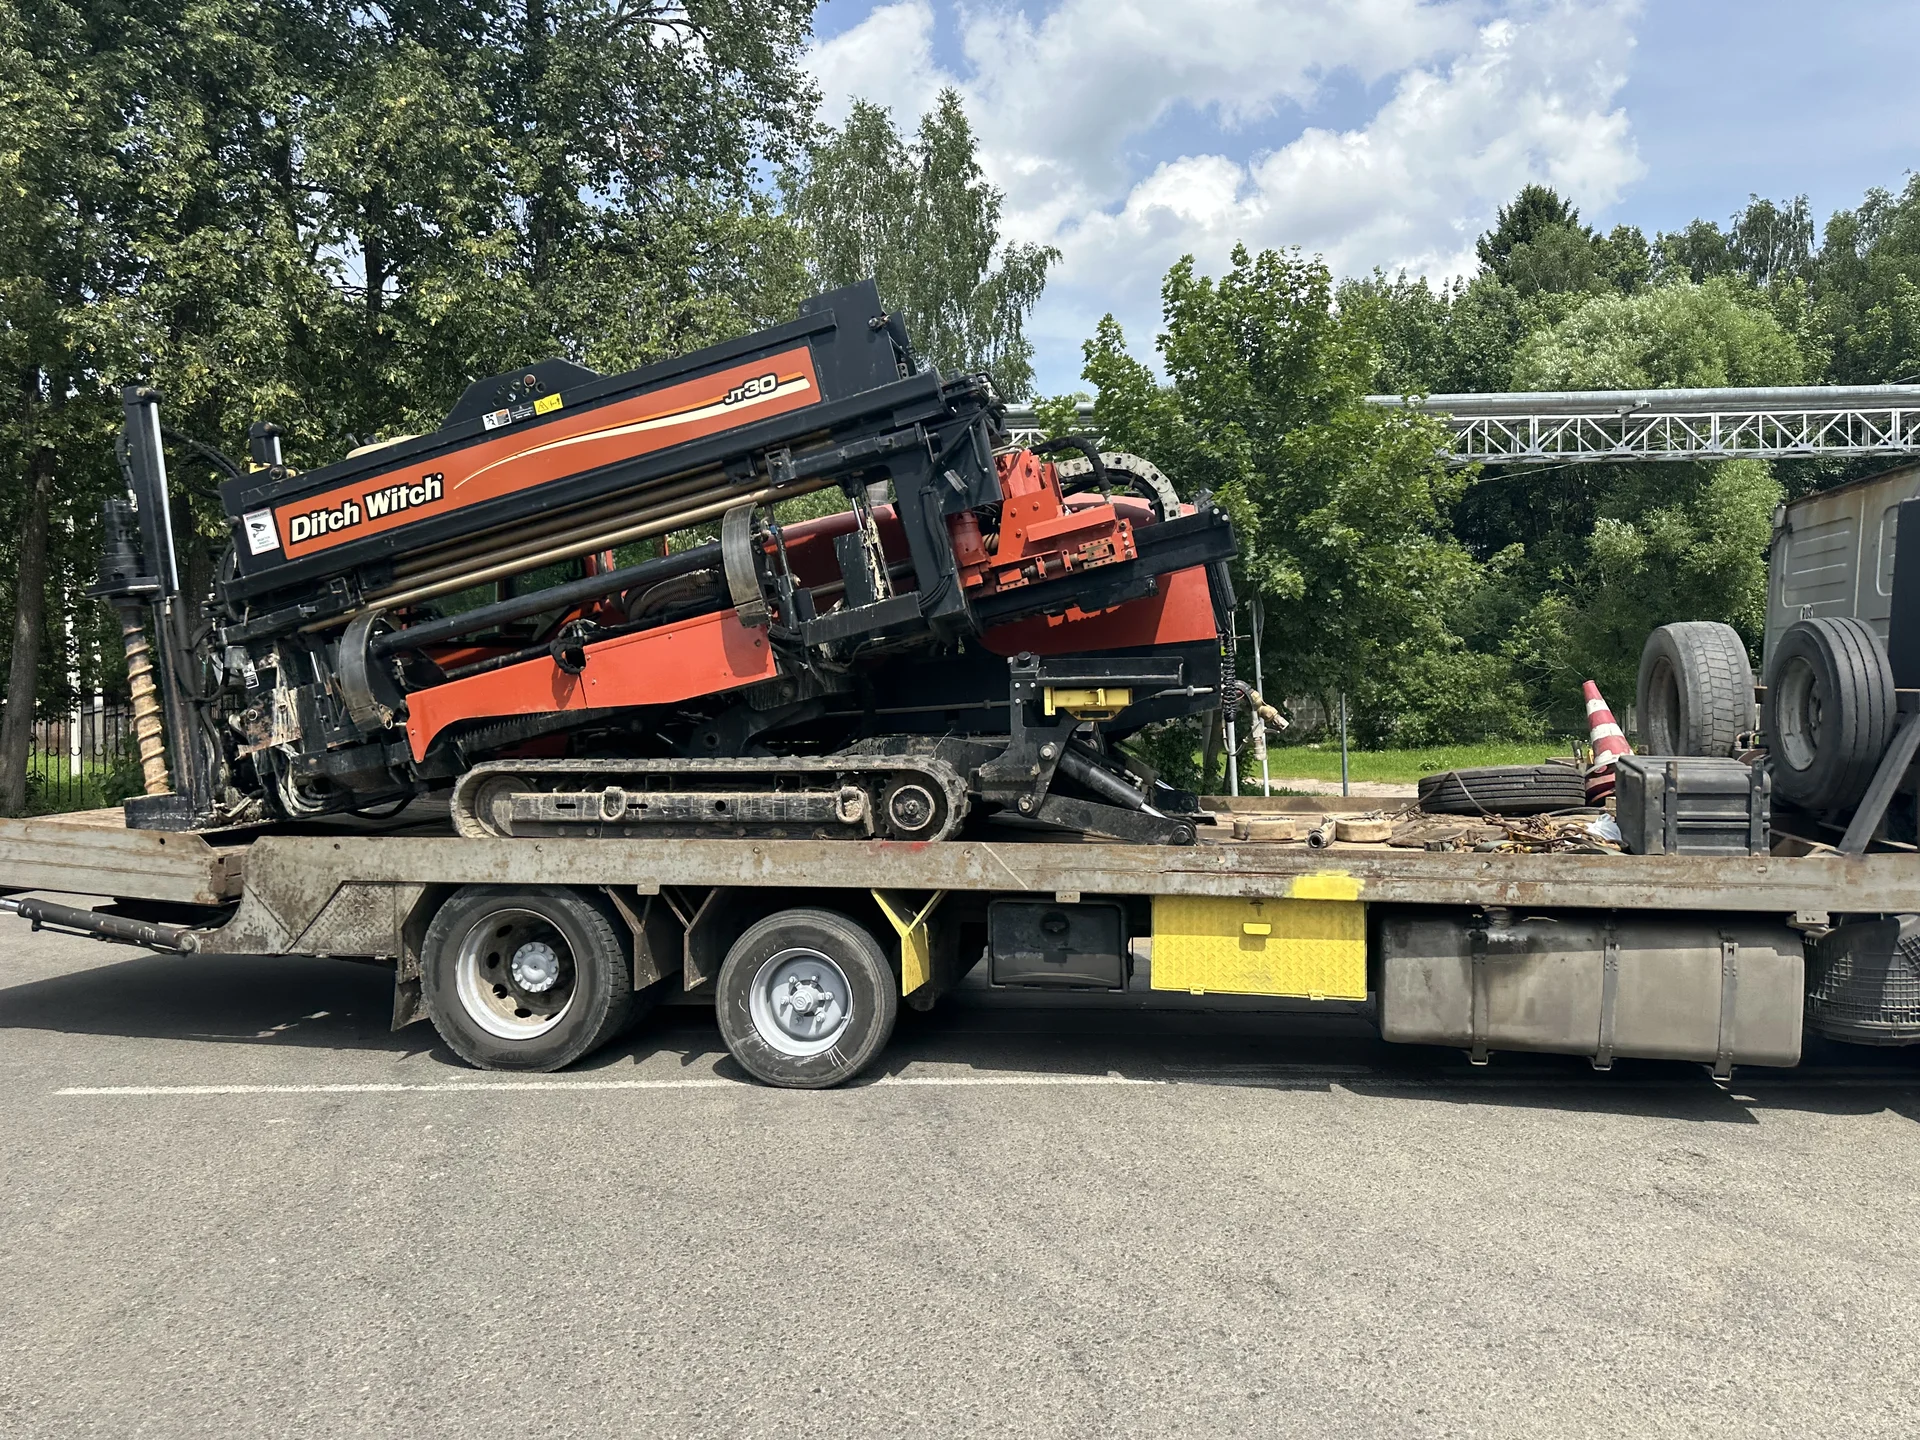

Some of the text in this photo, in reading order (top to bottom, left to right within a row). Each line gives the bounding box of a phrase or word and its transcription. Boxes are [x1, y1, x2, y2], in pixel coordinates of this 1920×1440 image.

[724, 374, 777, 404] JT30
[291, 475, 443, 543] Ditch Witch
